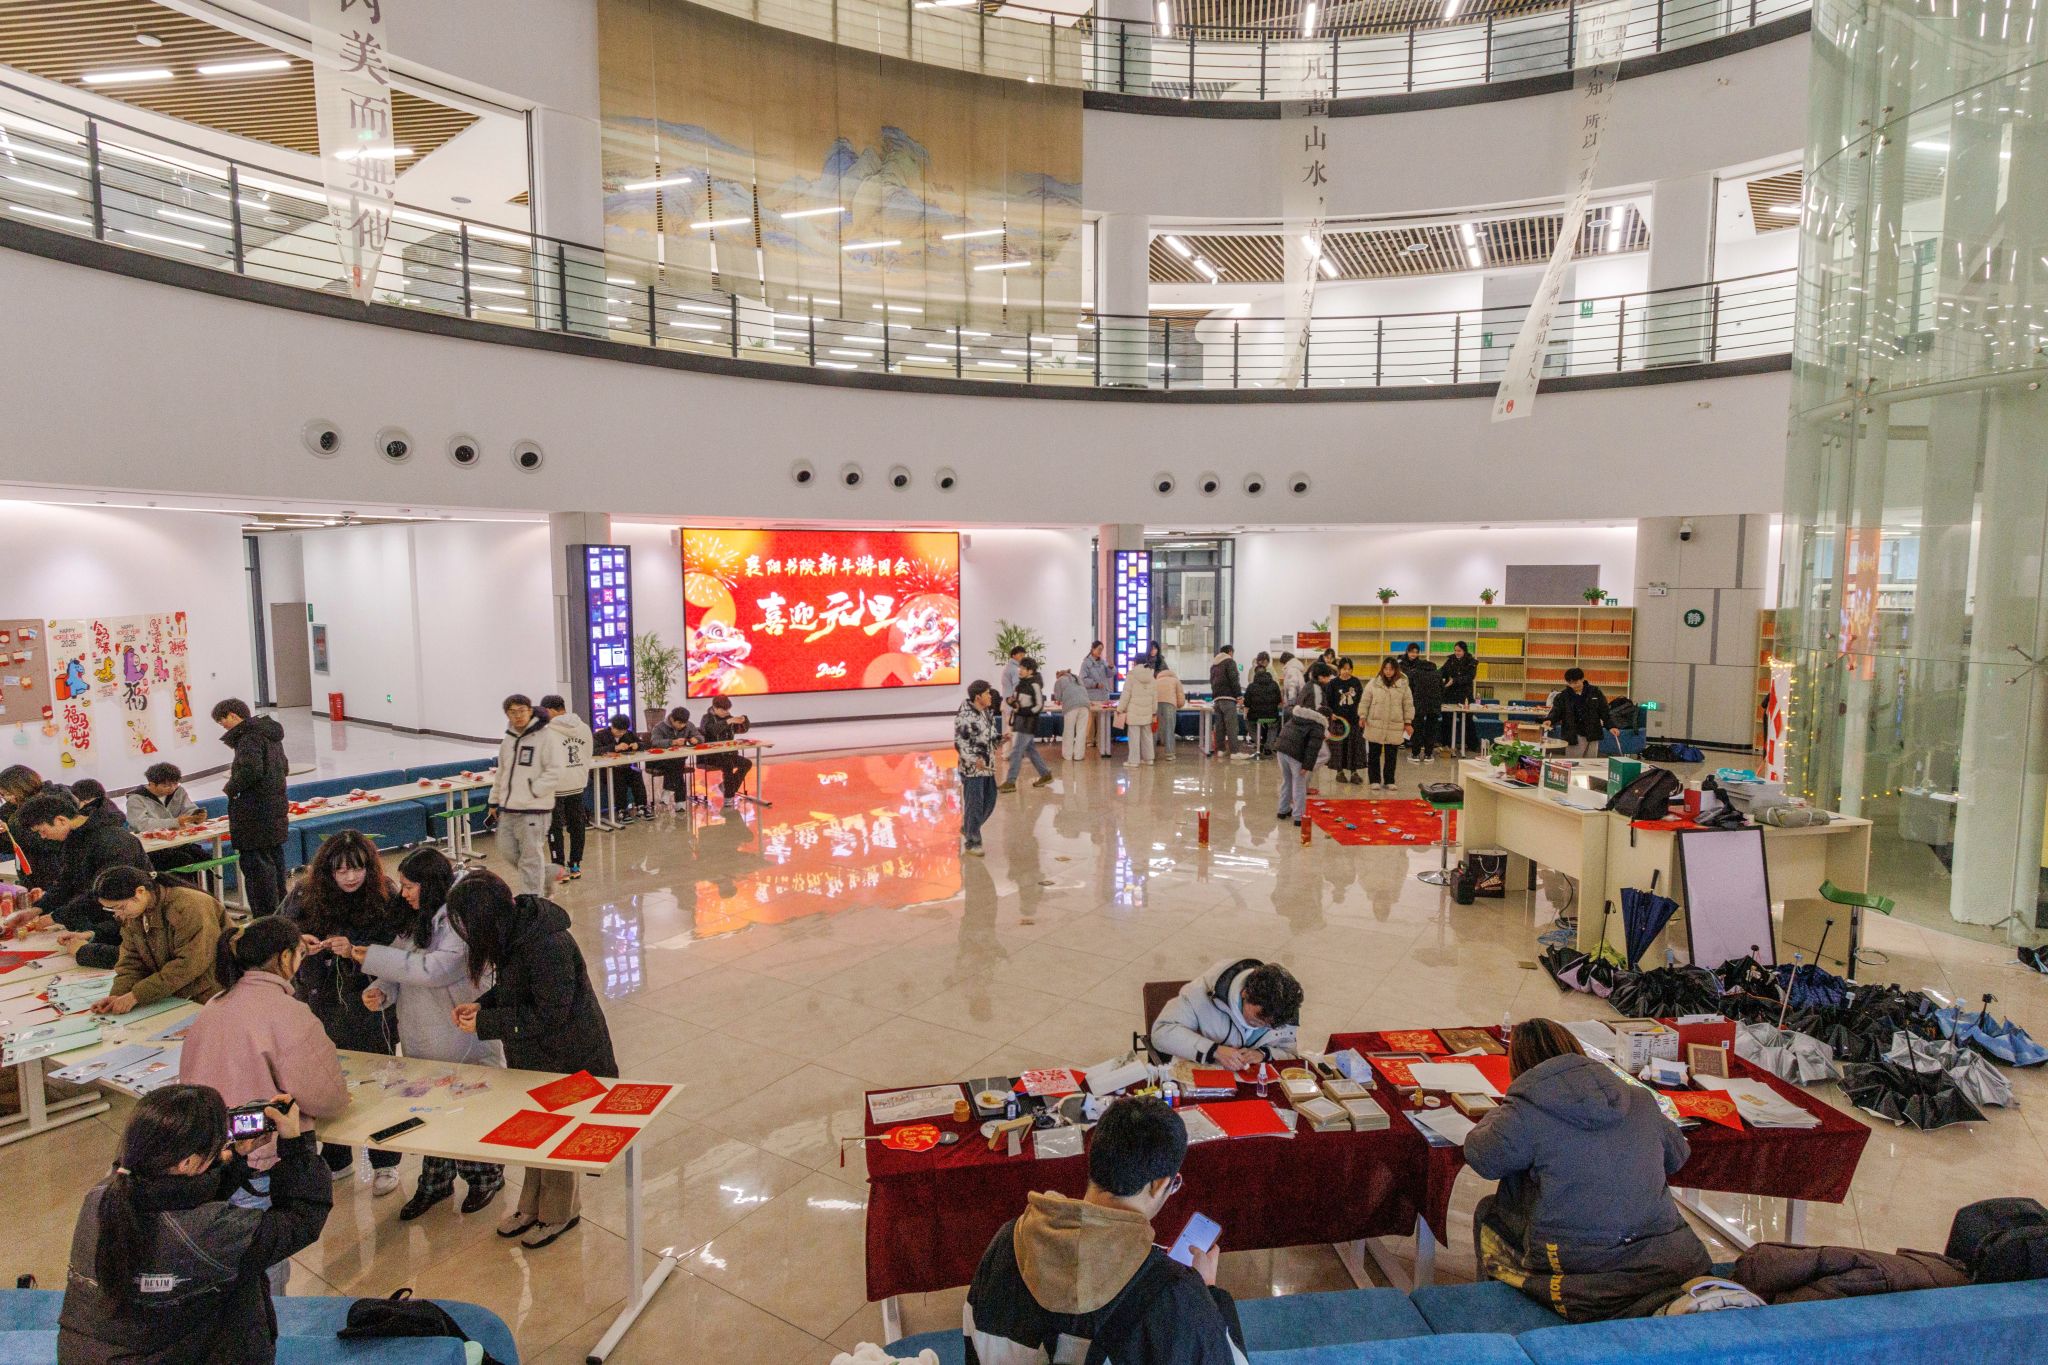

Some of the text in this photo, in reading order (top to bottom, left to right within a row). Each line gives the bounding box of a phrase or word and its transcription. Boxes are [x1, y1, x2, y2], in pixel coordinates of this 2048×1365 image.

[744, 552, 910, 577] 襄阳书院新年游园会
[752, 589, 898, 643] 喜迎元旦
[1687, 612, 1701, 625] 静
[815, 661, 847, 679] 2026
